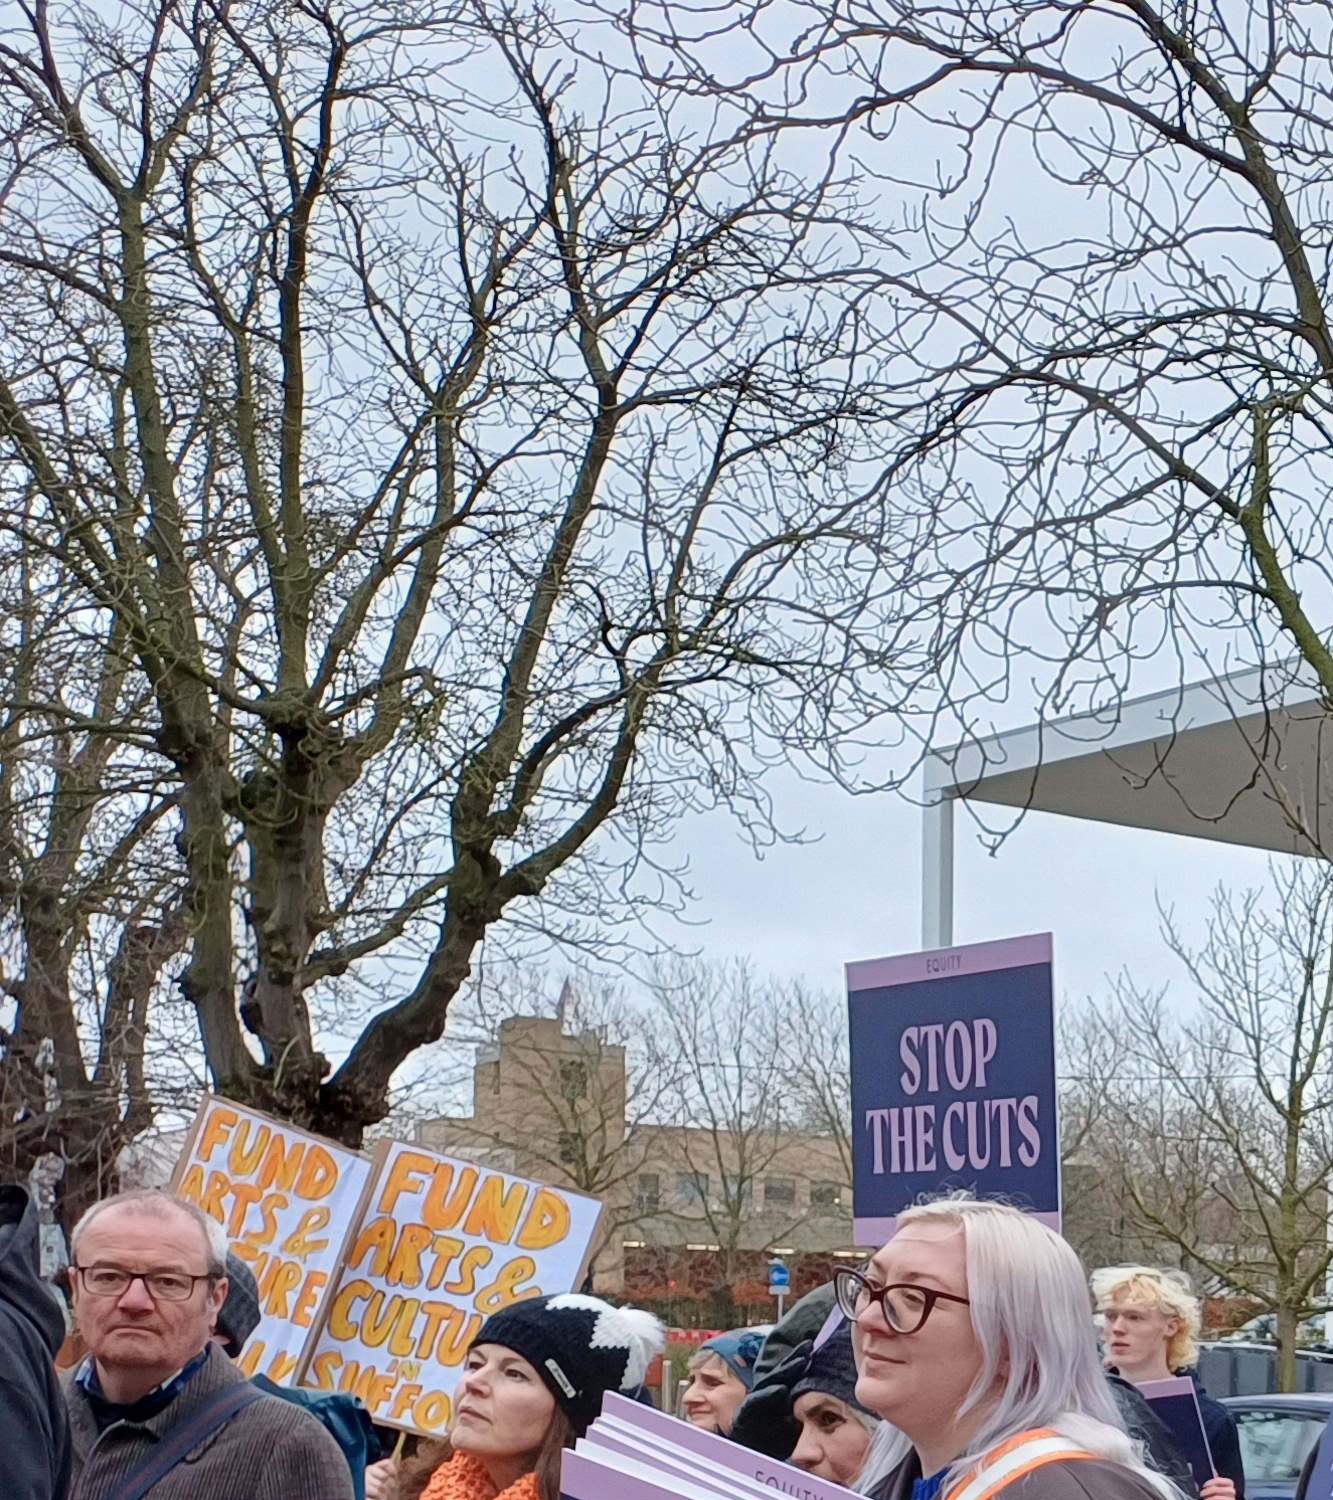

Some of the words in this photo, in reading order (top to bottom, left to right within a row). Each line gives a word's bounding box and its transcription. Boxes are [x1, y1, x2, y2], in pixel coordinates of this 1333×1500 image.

[926, 954, 962, 974] EQUITY
[900, 1018, 997, 1095] STOP
[197, 1107, 339, 1201] FUND
[866, 1104, 937, 1174] THE
[943, 1095, 1041, 1171] CUTS
[180, 1164, 289, 1246] ARTS
[282, 1206, 331, 1262] &
[377, 1151, 571, 1250] FUND
[348, 1215, 493, 1296] ARTS
[473, 1255, 542, 1314] &
[327, 1279, 484, 1367] CULTU
